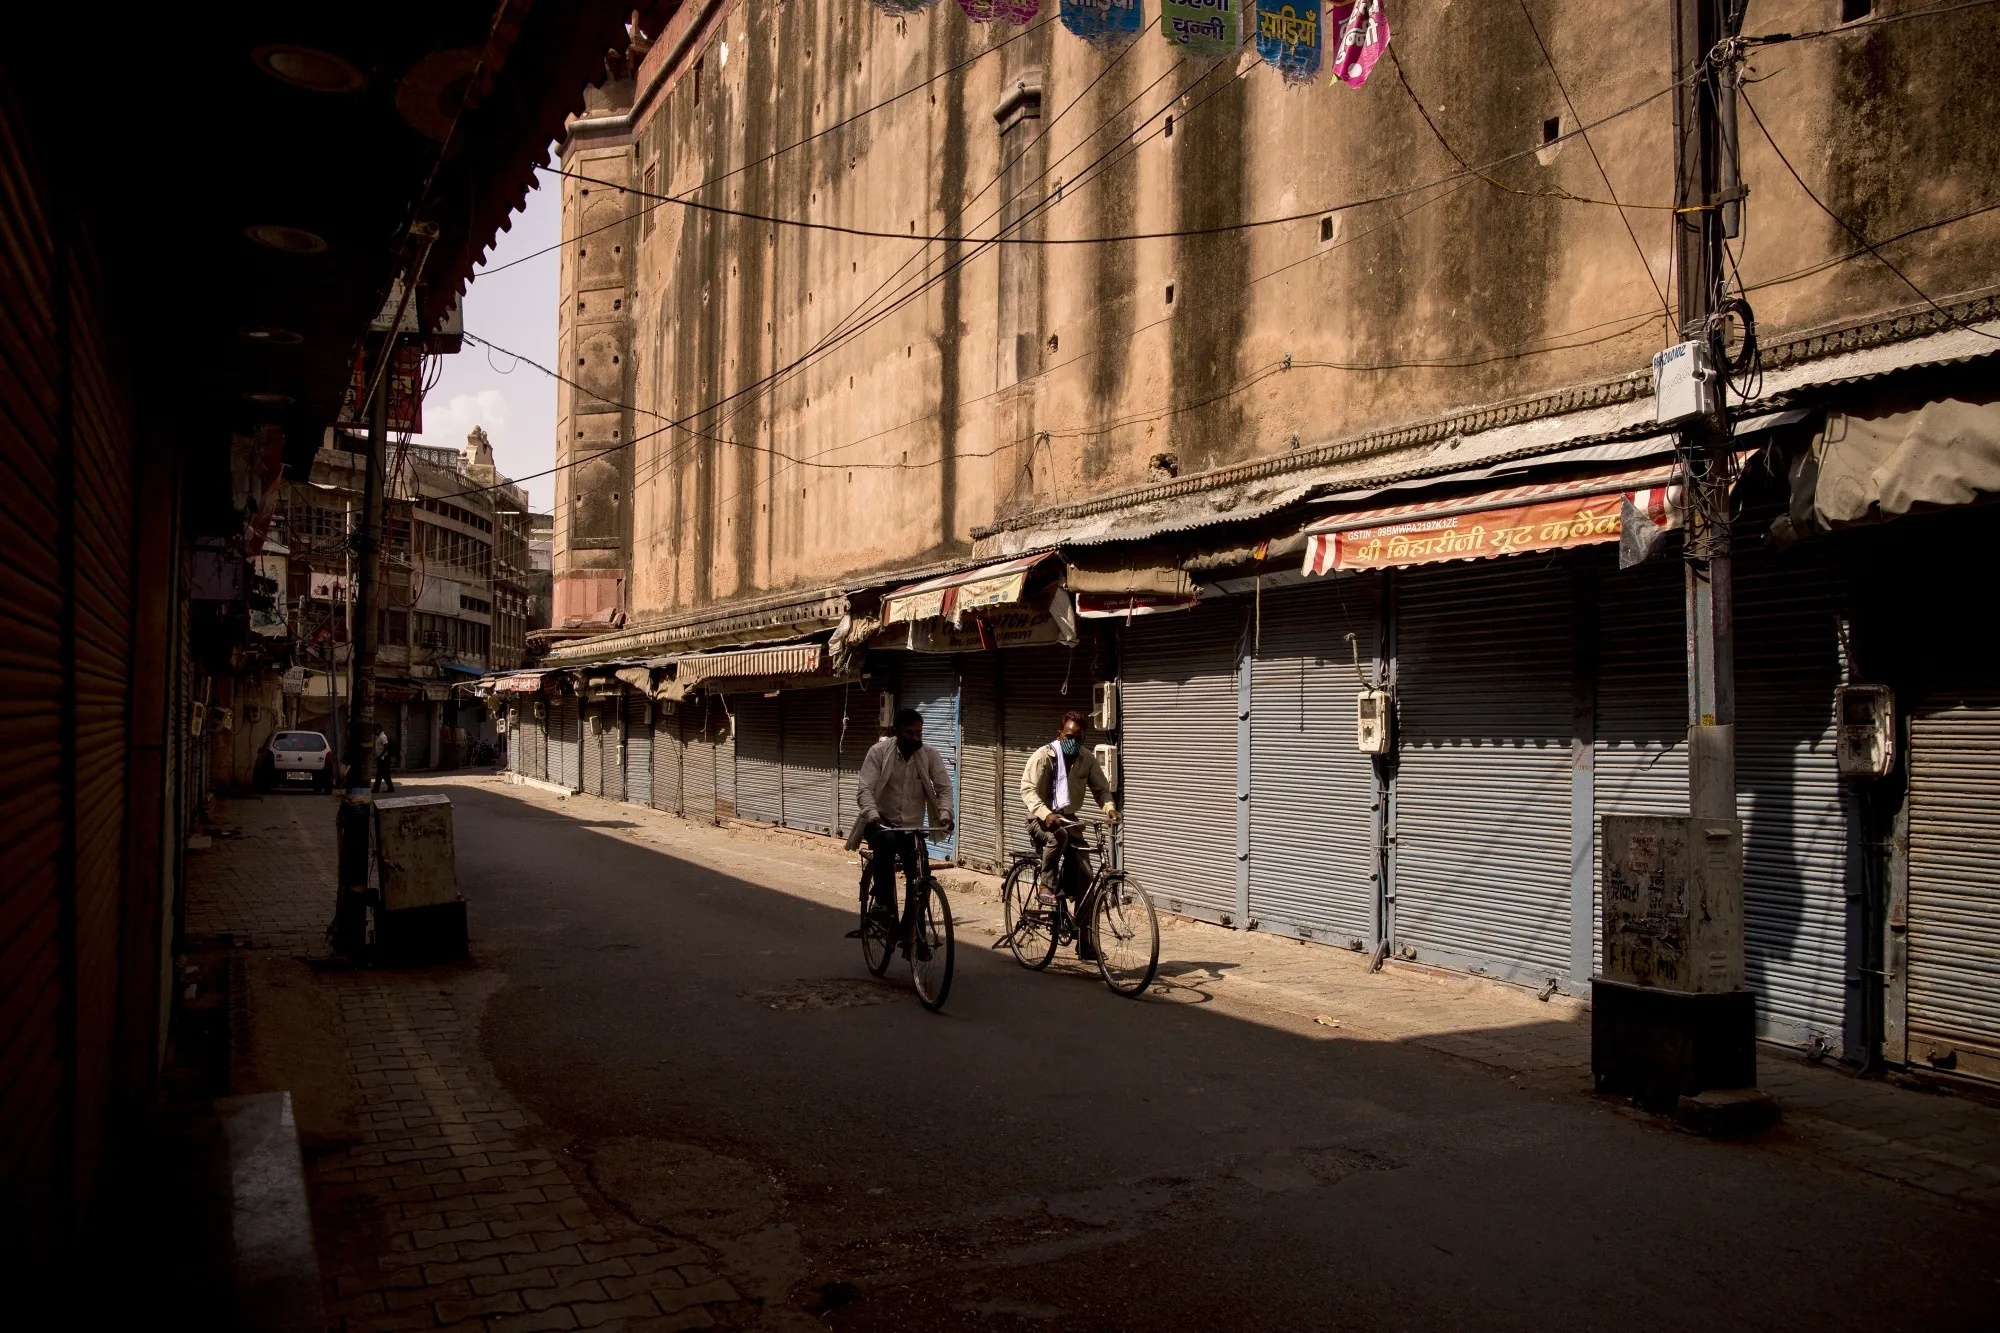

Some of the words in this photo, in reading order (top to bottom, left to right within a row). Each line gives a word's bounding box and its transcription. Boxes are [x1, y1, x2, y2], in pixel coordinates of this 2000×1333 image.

[1172, 16, 1226, 45] चुन्नी
[1347, 530, 1371, 541] GSTIN
[1356, 539, 1382, 561] श्री
[1490, 525, 1536, 552] सूट
